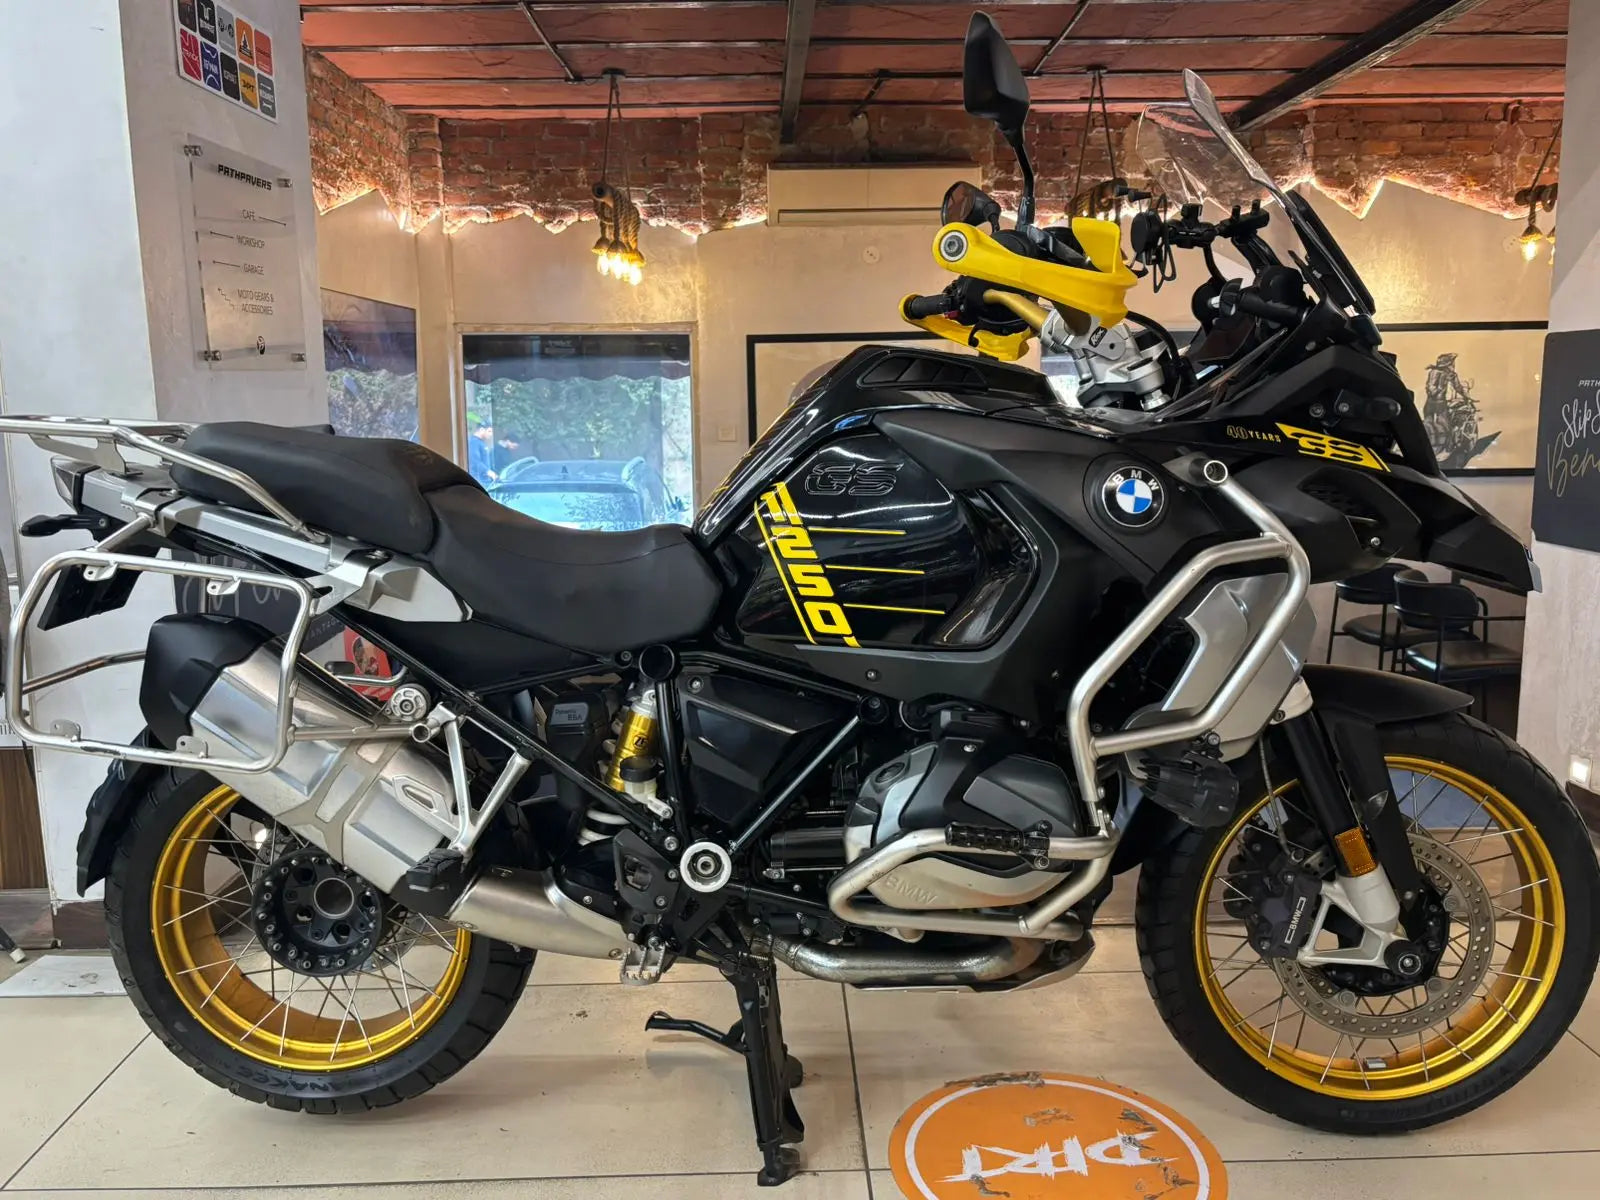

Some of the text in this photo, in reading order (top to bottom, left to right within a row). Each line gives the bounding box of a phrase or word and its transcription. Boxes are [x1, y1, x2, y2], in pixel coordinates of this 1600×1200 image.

[217, 164, 272, 190] PATHPAVERS
[236, 234, 265, 248] WORKSHOP
[243, 263, 264, 276] GARAGE
[242, 303, 273, 315] ACCESSORIES
[1248, 430, 1281, 443] YEARS
[803, 461, 905, 496] GS
[1110, 469, 1161, 492] BMW
[634, 736, 649, 746] ZF
[886, 872, 938, 905] BMW
[1289, 908, 1303, 930] BMW
